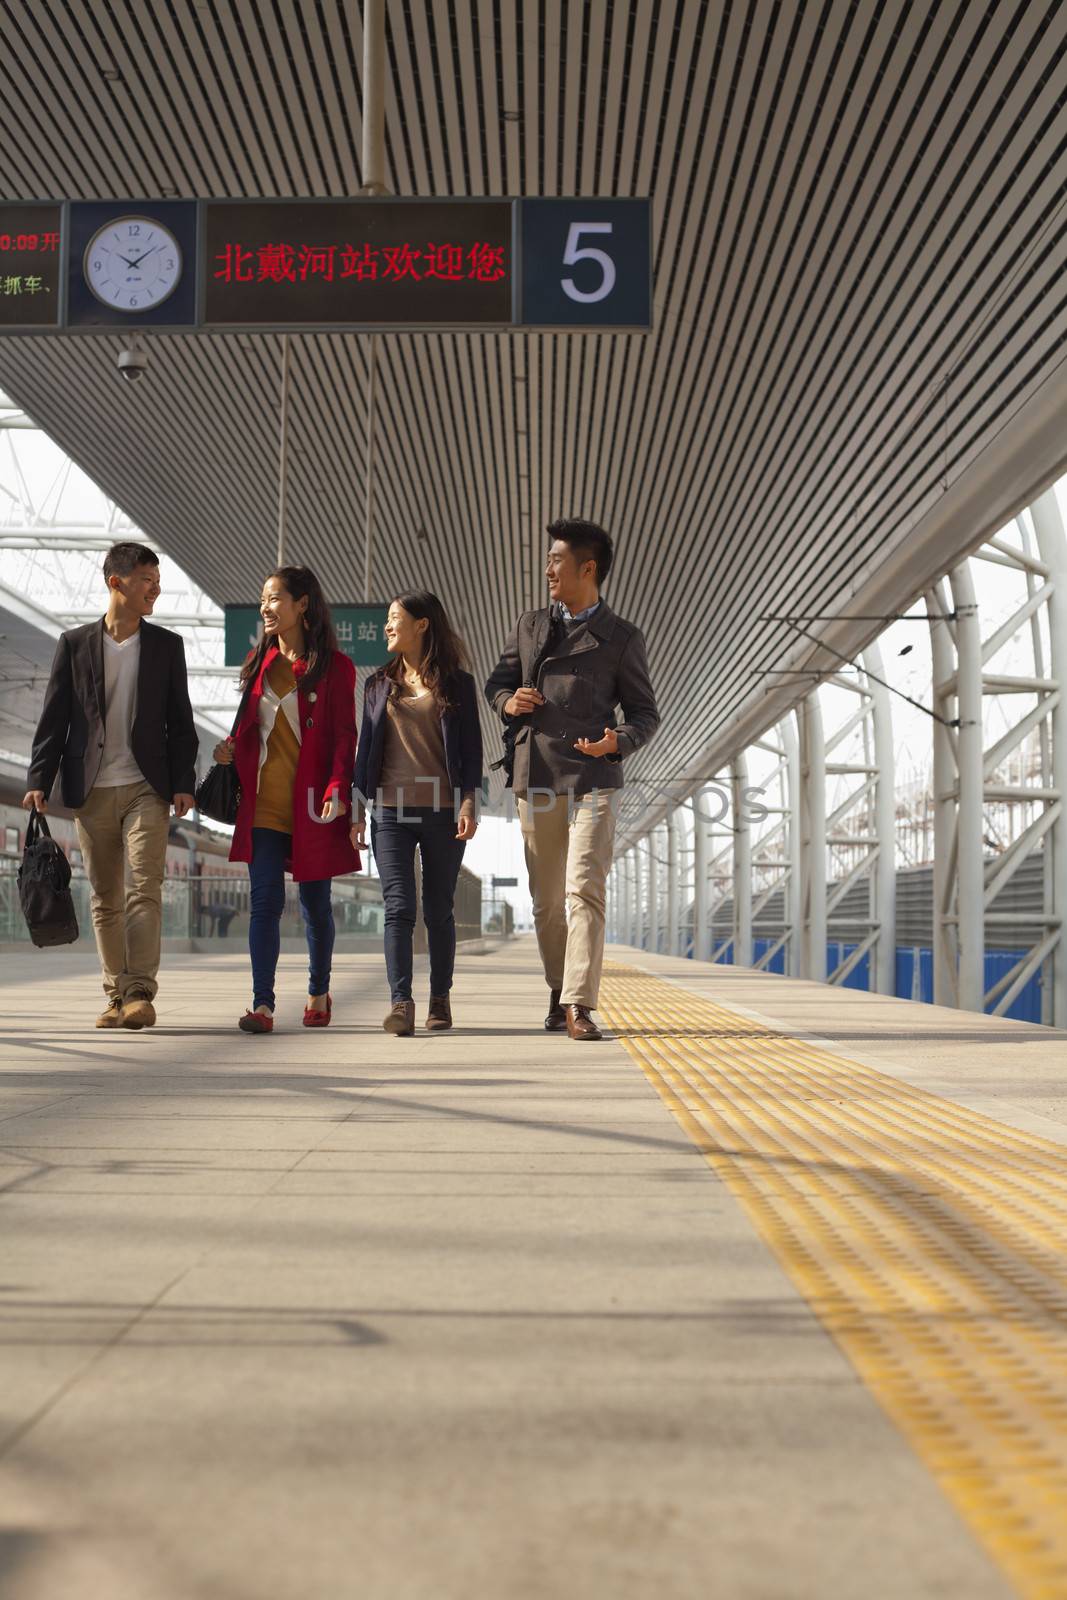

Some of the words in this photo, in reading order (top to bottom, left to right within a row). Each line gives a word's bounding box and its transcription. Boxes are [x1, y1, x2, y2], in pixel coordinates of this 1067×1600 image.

[129, 225, 141, 236] 12
[94, 261, 102, 272] 9
[166, 259, 175, 271] 3
[213, 242, 506, 283] 北戴河站欢迎您
[560, 222, 617, 304] 5
[130, 294, 138, 306] 6
[336, 621, 386, 642] 出站
